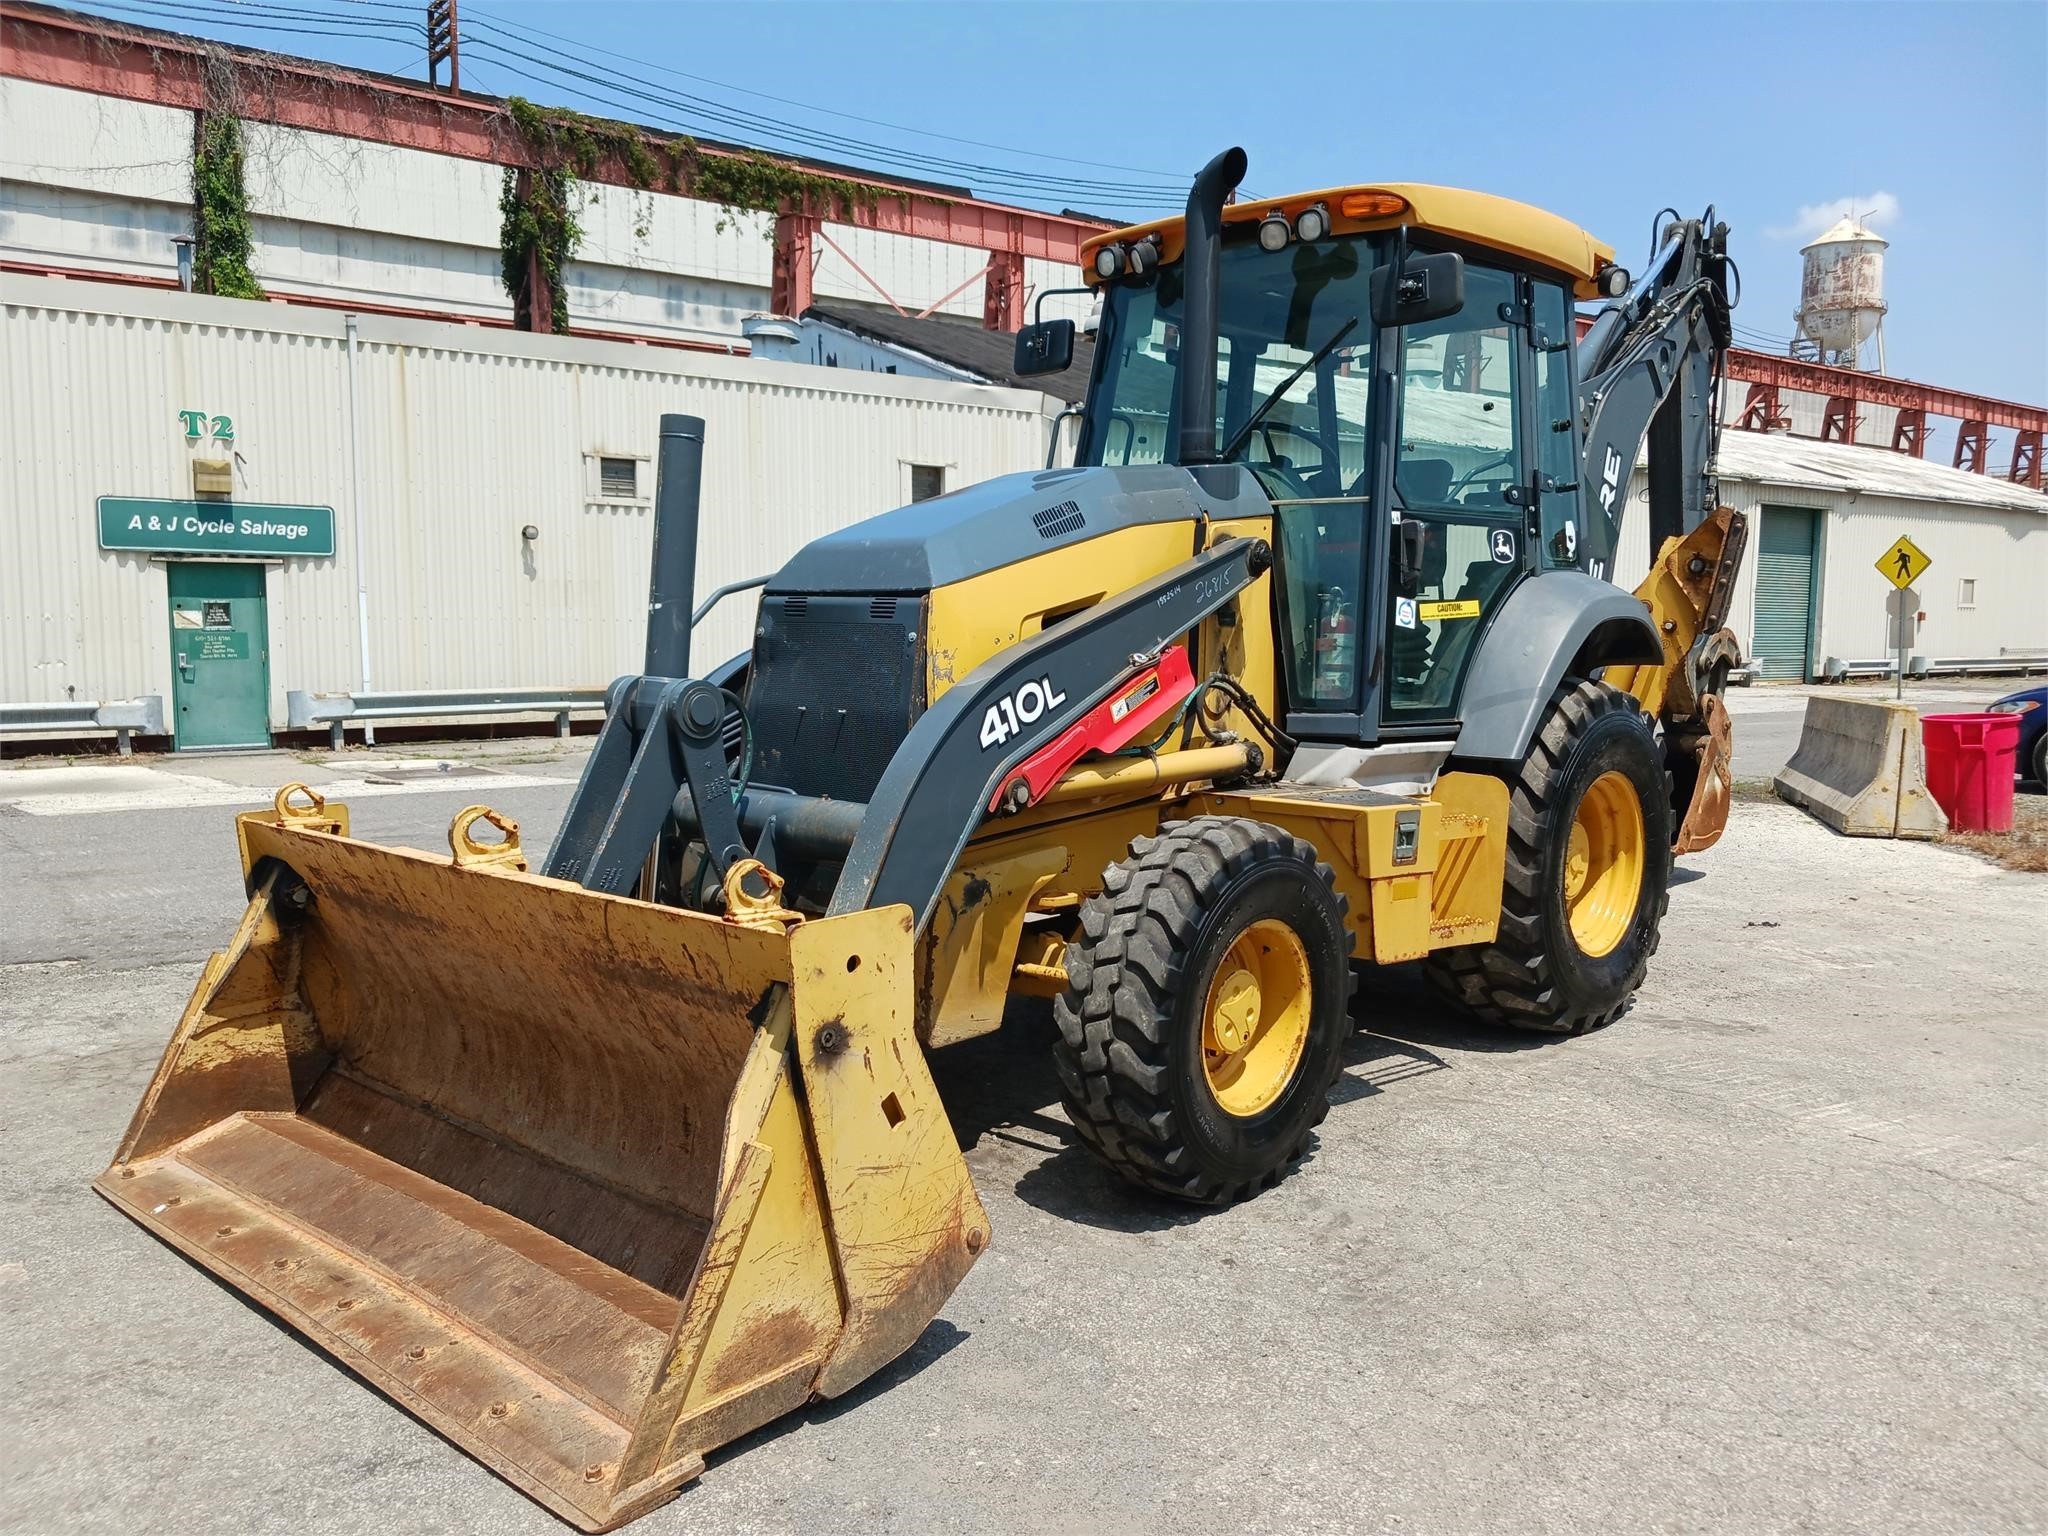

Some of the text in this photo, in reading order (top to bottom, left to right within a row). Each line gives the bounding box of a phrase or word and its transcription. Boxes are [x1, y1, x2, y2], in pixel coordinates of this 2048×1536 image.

[128, 515, 308, 539] A & J Cycle Salvage
[980, 677, 1066, 749] 410L
